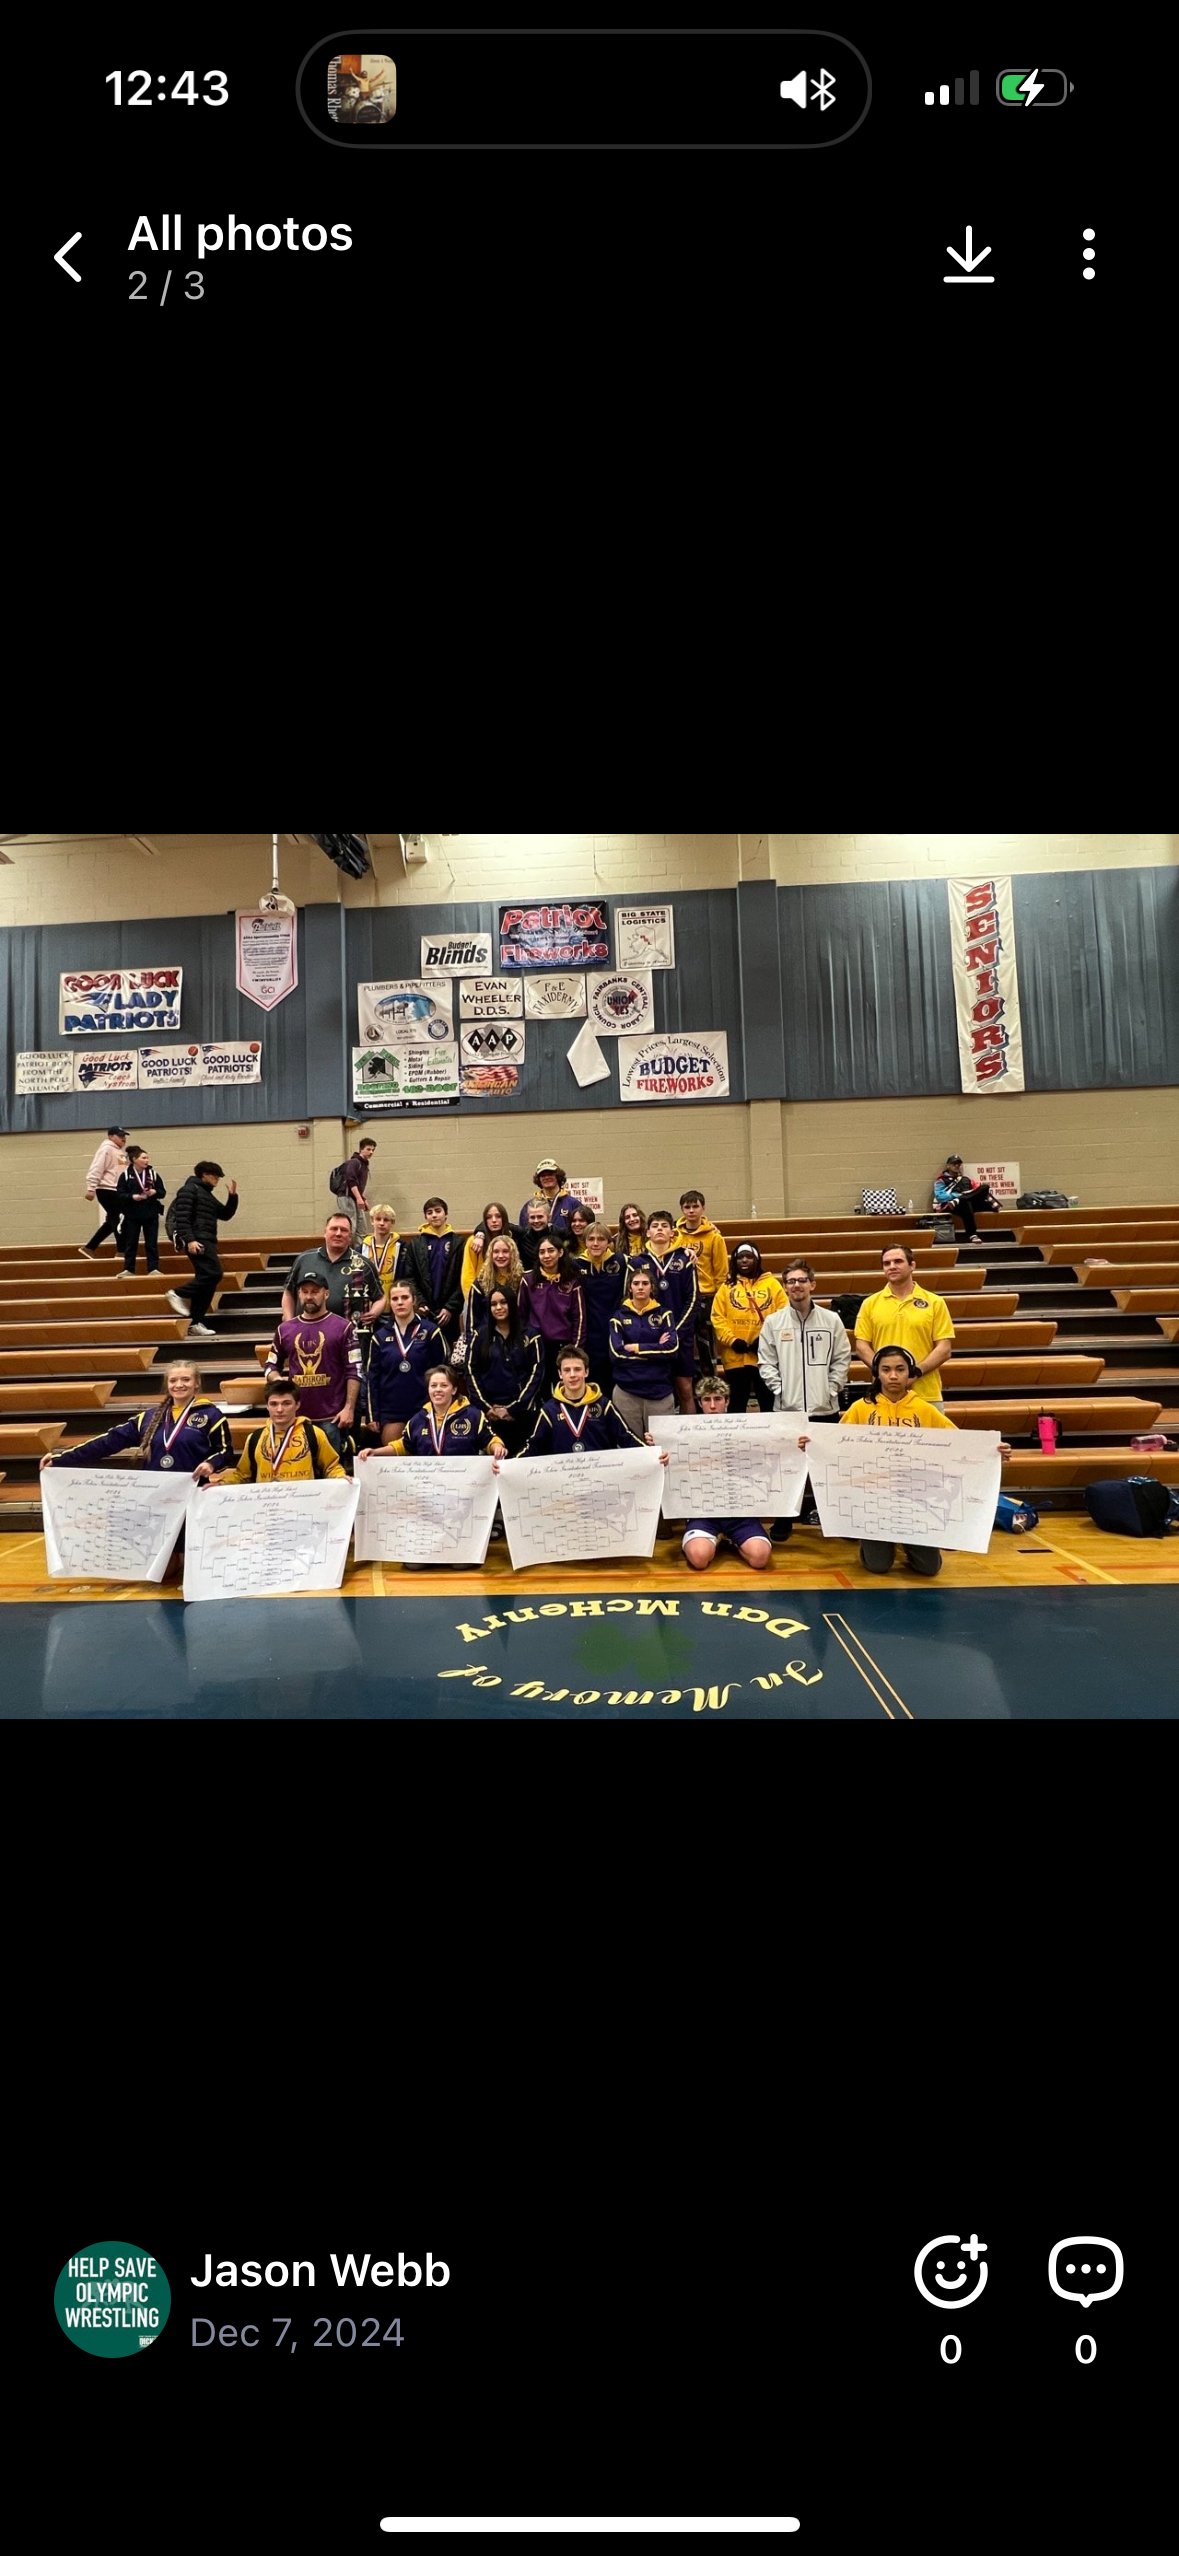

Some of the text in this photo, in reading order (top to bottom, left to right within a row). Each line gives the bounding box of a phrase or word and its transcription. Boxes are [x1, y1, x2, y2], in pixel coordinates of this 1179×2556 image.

[500, 905, 607, 934] Patriot
[448, 941, 472, 950] Budget
[500, 940, 608, 962] Fireworks
[426, 945, 488, 966] Blinds
[64, 970, 180, 992] GOOD LUCK
[964, 881, 1009, 1087] SENIORS
[261, 985, 276, 994] GCI
[364, 984, 398, 992] PLUMBERS
[475, 982, 507, 992] EVAN
[545, 982, 551, 992] F
[558, 982, 566, 991] E
[114, 990, 178, 1010] LADY
[462, 994, 522, 1004] WHEELER
[532, 992, 580, 1012] TAXIDERMY
[592, 976, 648, 1029] FAIRBANKS CENTRAL LABOR COUNCIL
[607, 996, 634, 1004] UNION
[474, 1006, 510, 1016] D.D.S.
[616, 1006, 629, 1016] YES
[64, 1010, 180, 1032] PATRIOTS
[82, 1053, 131, 1062] Good Luck
[142, 1058, 198, 1068] GOOD LUCK
[203, 1054, 259, 1064] GOOD LUCK
[622, 1057, 641, 1088] Lowest
[667, 1036, 700, 1050] Largest
[700, 1046, 726, 1082] Selection
[78, 1062, 134, 1073] PATRIOTS
[208, 1064, 254, 1074] PATRIOTS!
[639, 1056, 710, 1076] BUDGET
[147, 1067, 192, 1078] PATRIOTS!
[636, 1076, 714, 1094] FIREWORKS
[364, 1101, 402, 1109] Commercial
[455, 1599, 811, 1642] Dan McHenry
[437, 1660, 824, 1712] In Memory of
